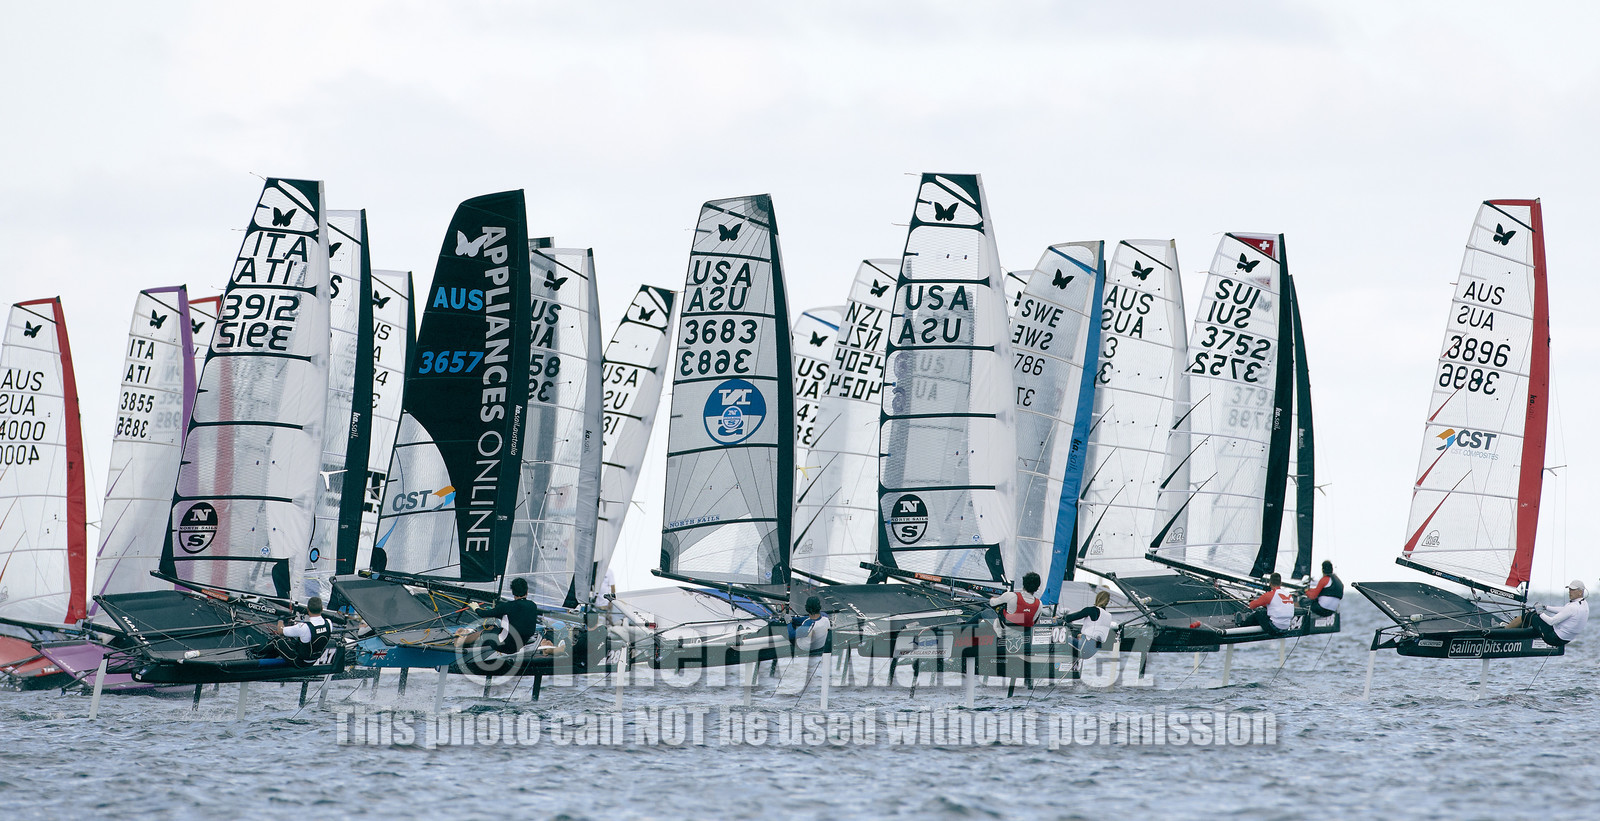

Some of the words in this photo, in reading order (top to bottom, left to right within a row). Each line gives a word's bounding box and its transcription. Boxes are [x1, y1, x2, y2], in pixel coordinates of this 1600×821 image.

[253, 232, 308, 262] ITA
[693, 260, 752, 288] USA
[433, 286, 484, 311] AUS
[905, 285, 969, 311] USA
[1104, 286, 1154, 315] AUS
[1215, 279, 1261, 310] SUI
[1463, 281, 1505, 306] AUS
[223, 294, 299, 321] 3912
[531, 299, 562, 325] US
[845, 301, 884, 332] NZL
[1021, 300, 1063, 328] SWE
[480, 226, 511, 423] APPLIANCES
[684, 319, 758, 345] 3683
[129, 339, 154, 360] ITA
[1201, 326, 1271, 361] 3752
[1447, 335, 1511, 368] 3896
[418, 351, 484, 374] 3657
[797, 357, 830, 381] US
[835, 347, 885, 378] 4024
[1, 369, 44, 391] AUS
[602, 364, 639, 388] USA
[121, 391, 155, 413] 3855
[1456, 429, 1497, 451] CST
[392, 490, 433, 512] CST
[466, 430, 504, 552] ONLINE
[190, 509, 212, 521] N
[900, 501, 920, 513] N
[669, 519, 695, 528] NORTH
[697, 515, 720, 523] SAILS
[901, 525, 918, 538] S
[187, 534, 205, 546] S
